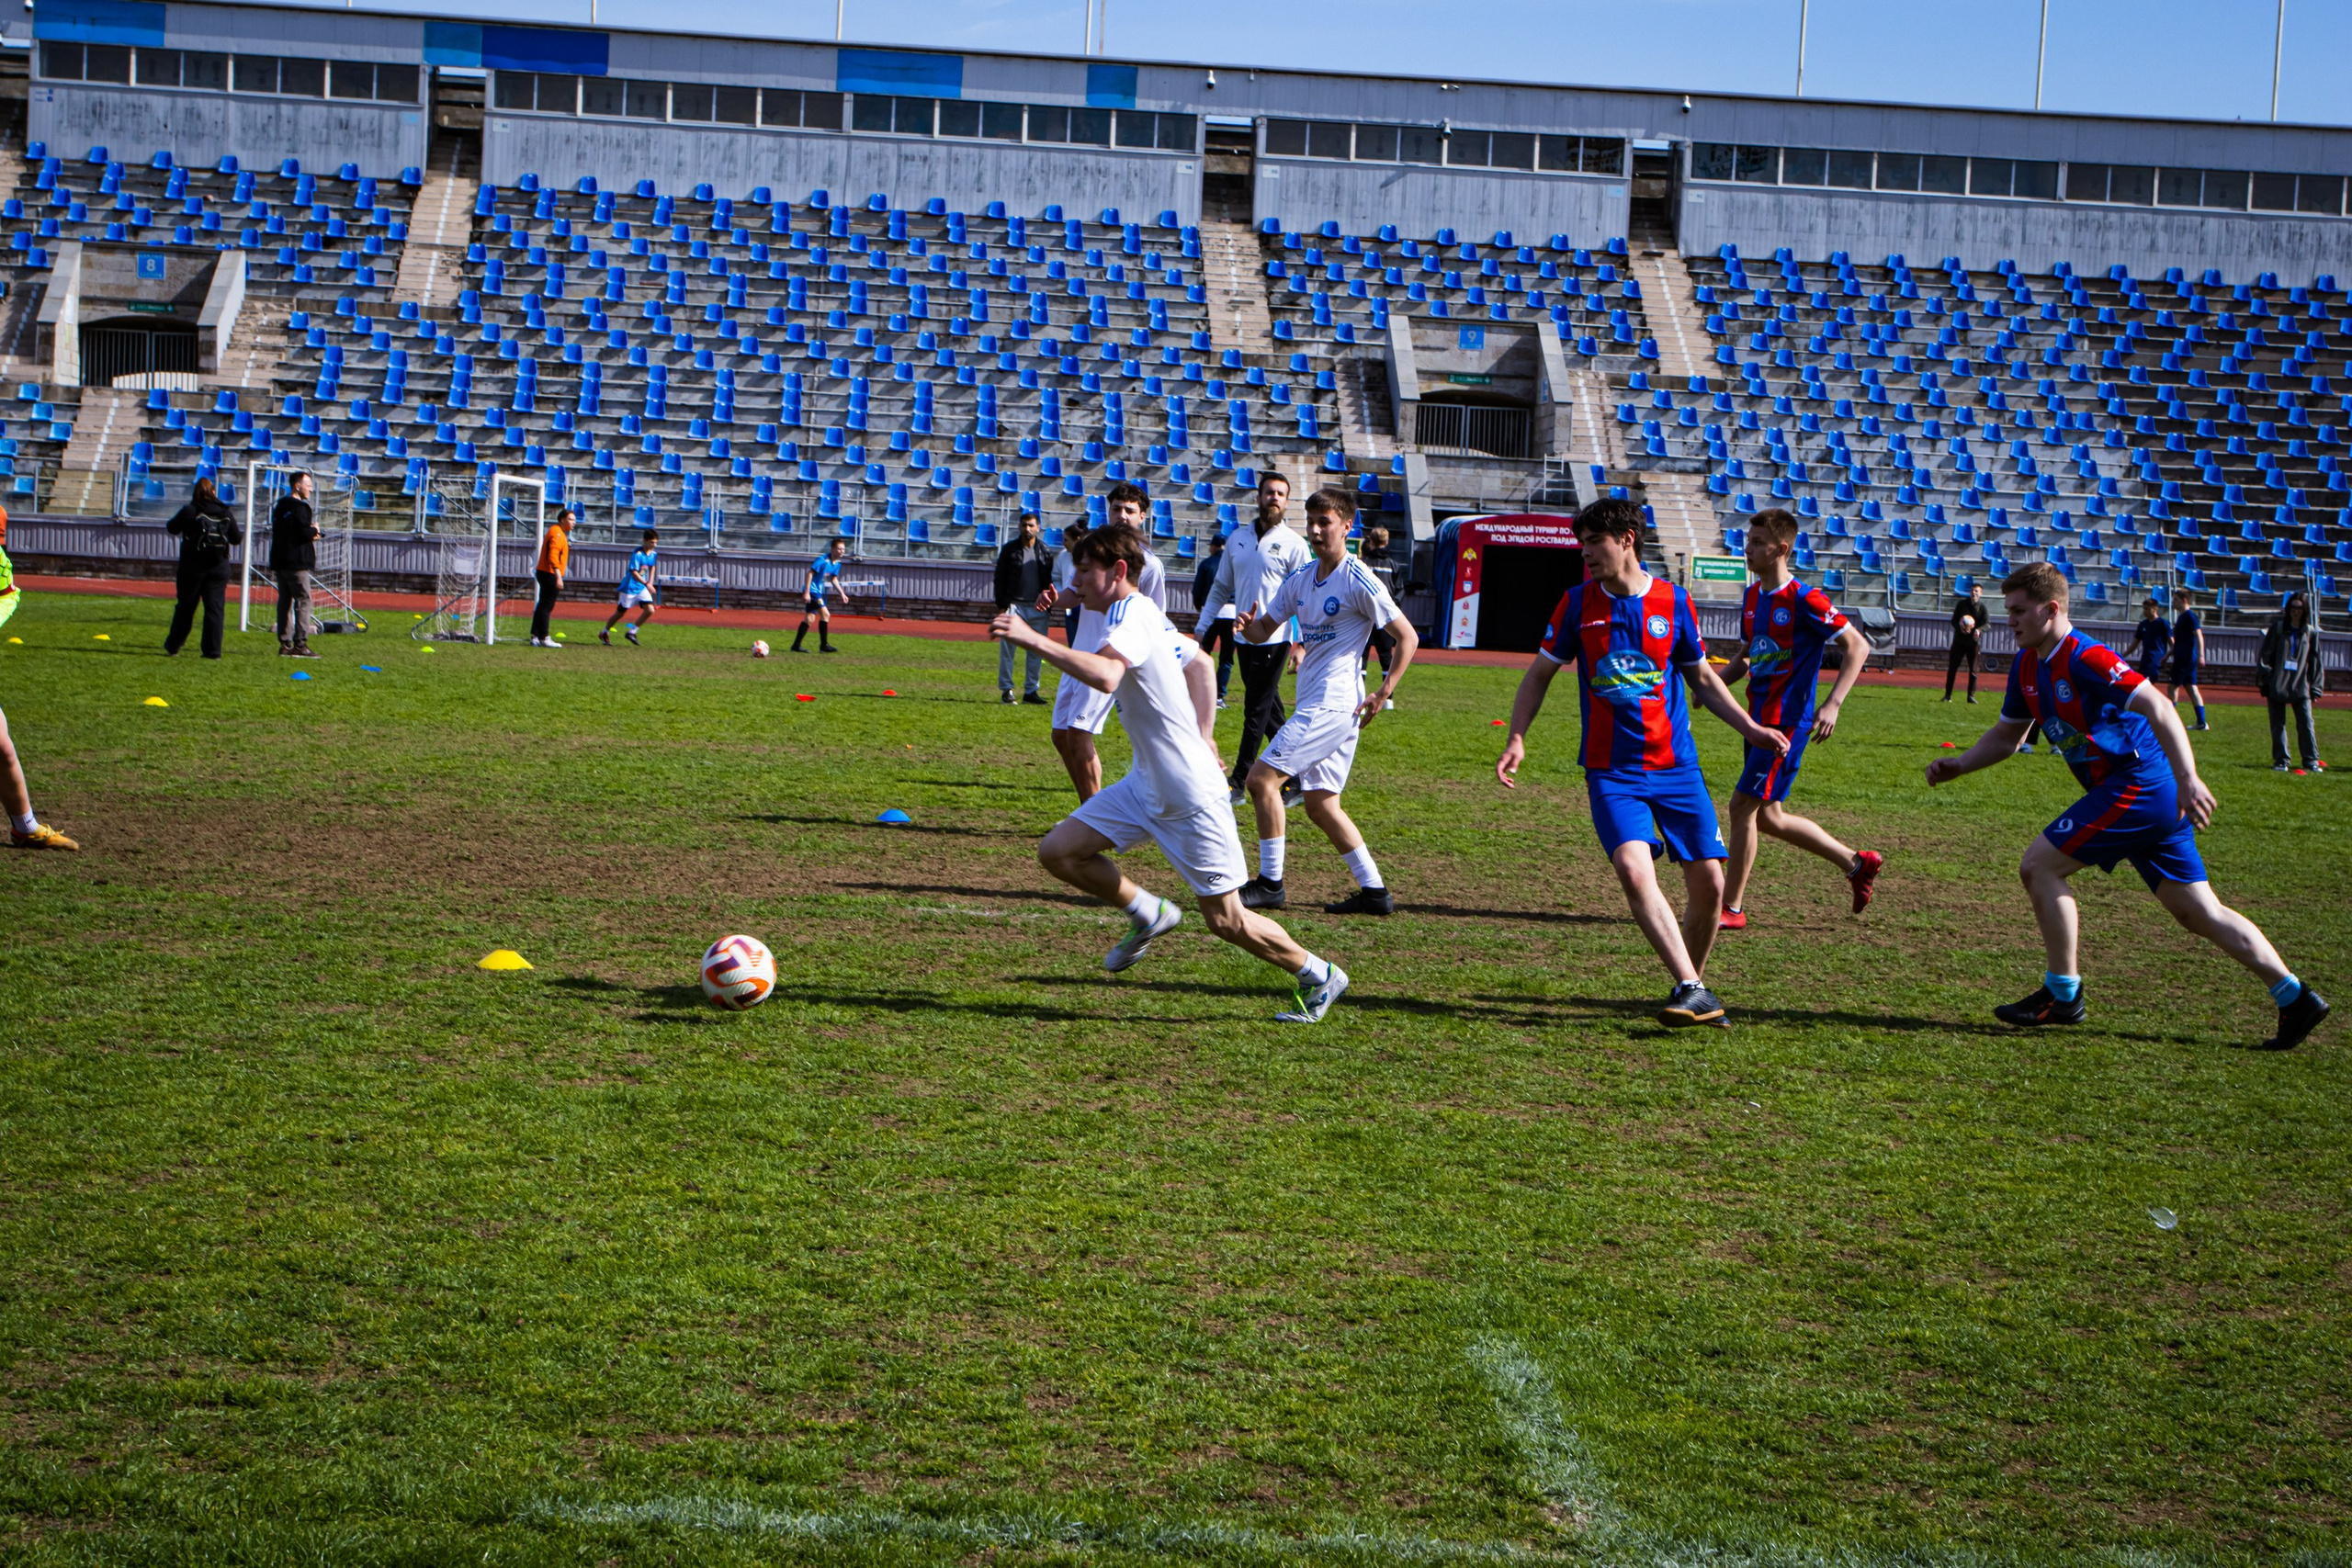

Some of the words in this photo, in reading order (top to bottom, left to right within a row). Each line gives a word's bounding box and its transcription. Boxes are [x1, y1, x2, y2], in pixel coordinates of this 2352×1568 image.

[146, 259, 155, 272] 8
[1467, 330, 1476, 343] 9
[1475, 524, 1534, 534] МЕЖДУНАРОДНЫЙ
[1535, 525, 1558, 535] ТУРНИР
[1559, 527, 1570, 536] ПО
[1490, 535, 1507, 543] ПОД
[1508, 535, 1534, 545] ЭГИДОЙ
[1302, 632, 1336, 643] ОРЯКОВ
[1753, 773, 1768, 790] 7
[2053, 818, 2073, 832] 9
[1715, 827, 1724, 846] 4
